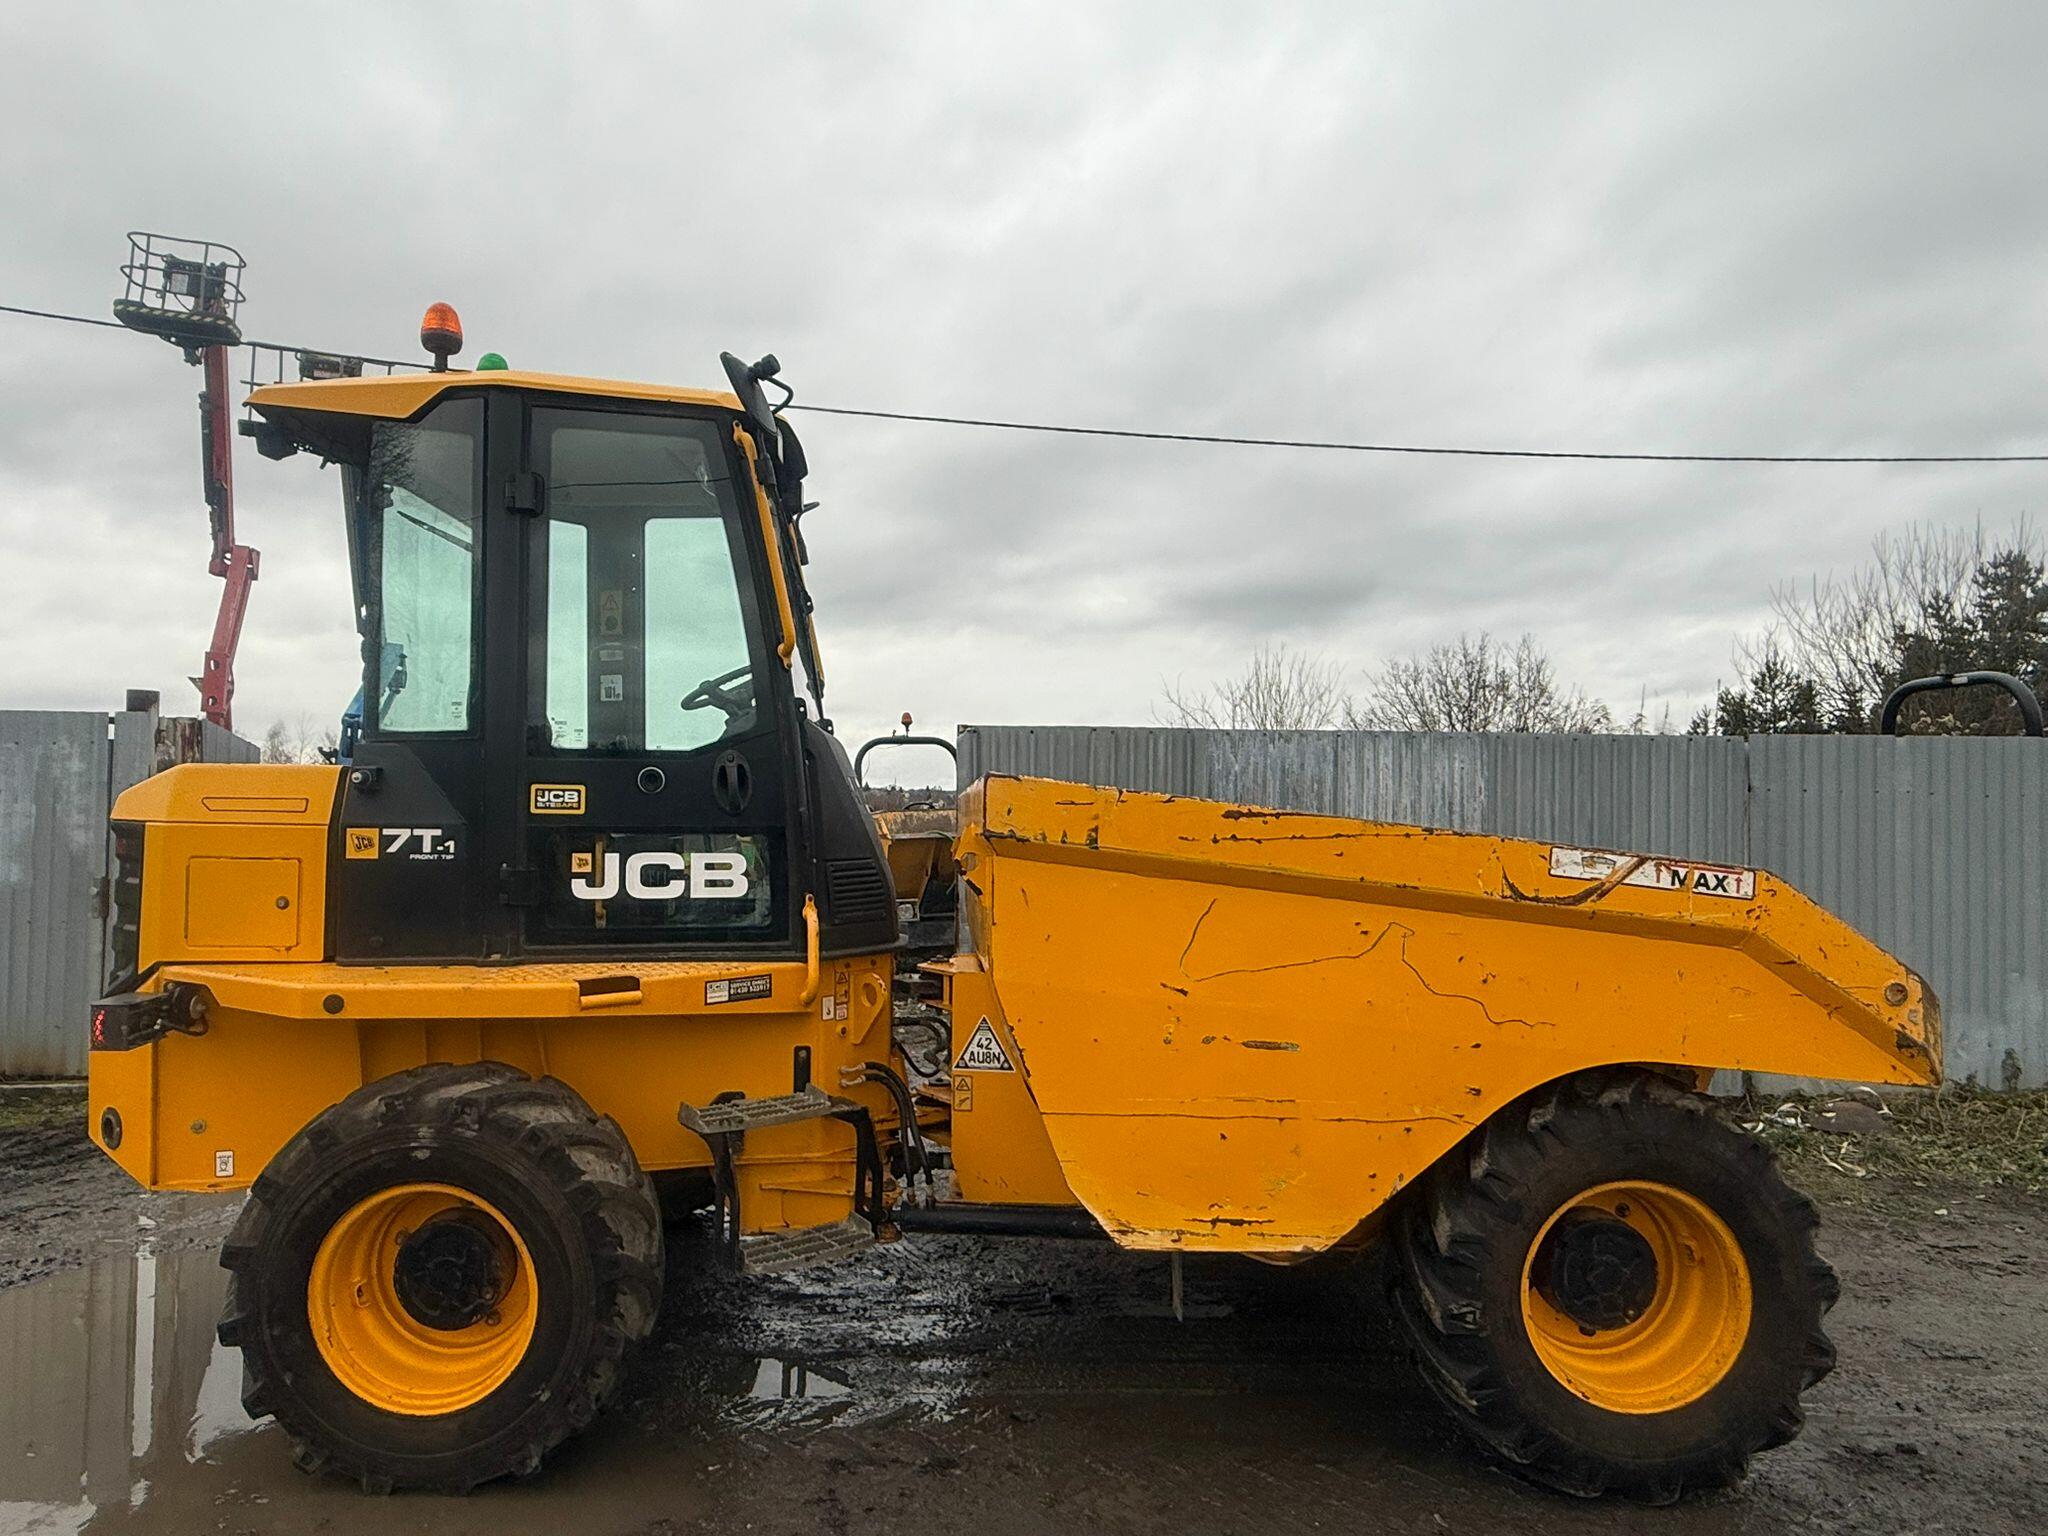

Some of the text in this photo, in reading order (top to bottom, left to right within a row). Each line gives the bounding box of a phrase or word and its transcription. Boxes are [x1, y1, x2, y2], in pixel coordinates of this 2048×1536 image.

[537, 790, 579, 802] JCB
[355, 835, 375, 850] JCB
[571, 852, 749, 899] JCB
[1671, 869, 1730, 893] MAX
[976, 1037, 993, 1050] 42
[968, 1051, 1001, 1064] AU8N
